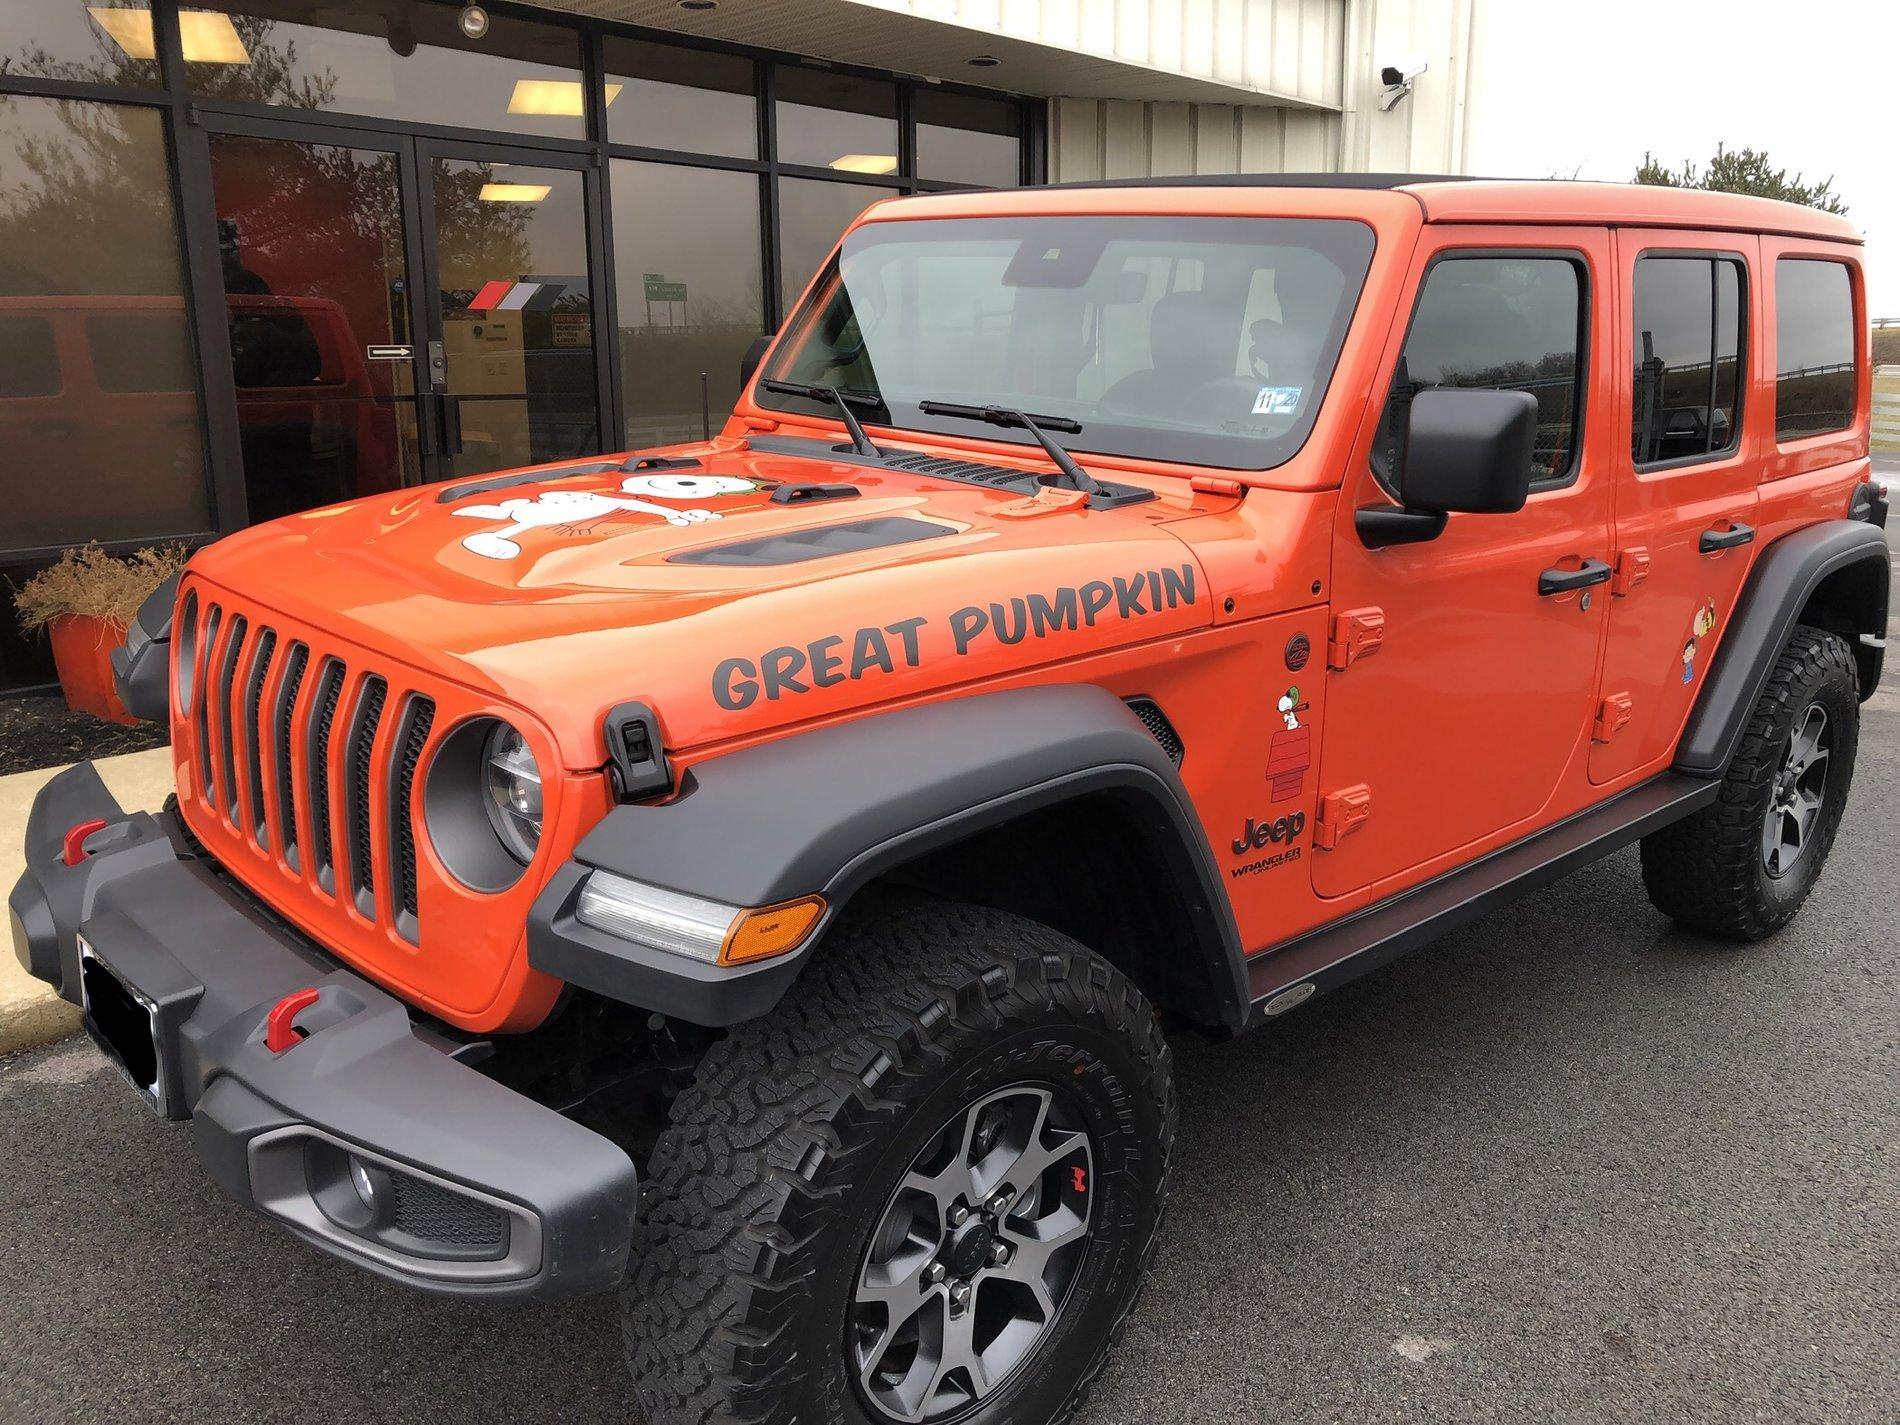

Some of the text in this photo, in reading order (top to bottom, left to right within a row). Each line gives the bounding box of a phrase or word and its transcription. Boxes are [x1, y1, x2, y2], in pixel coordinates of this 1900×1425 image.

[1259, 392, 1273, 409] 11
[712, 563, 1196, 711] GREAT PUMPKIN
[1232, 809, 1306, 856] Jeep
[1232, 847, 1301, 878] WRANGLER
